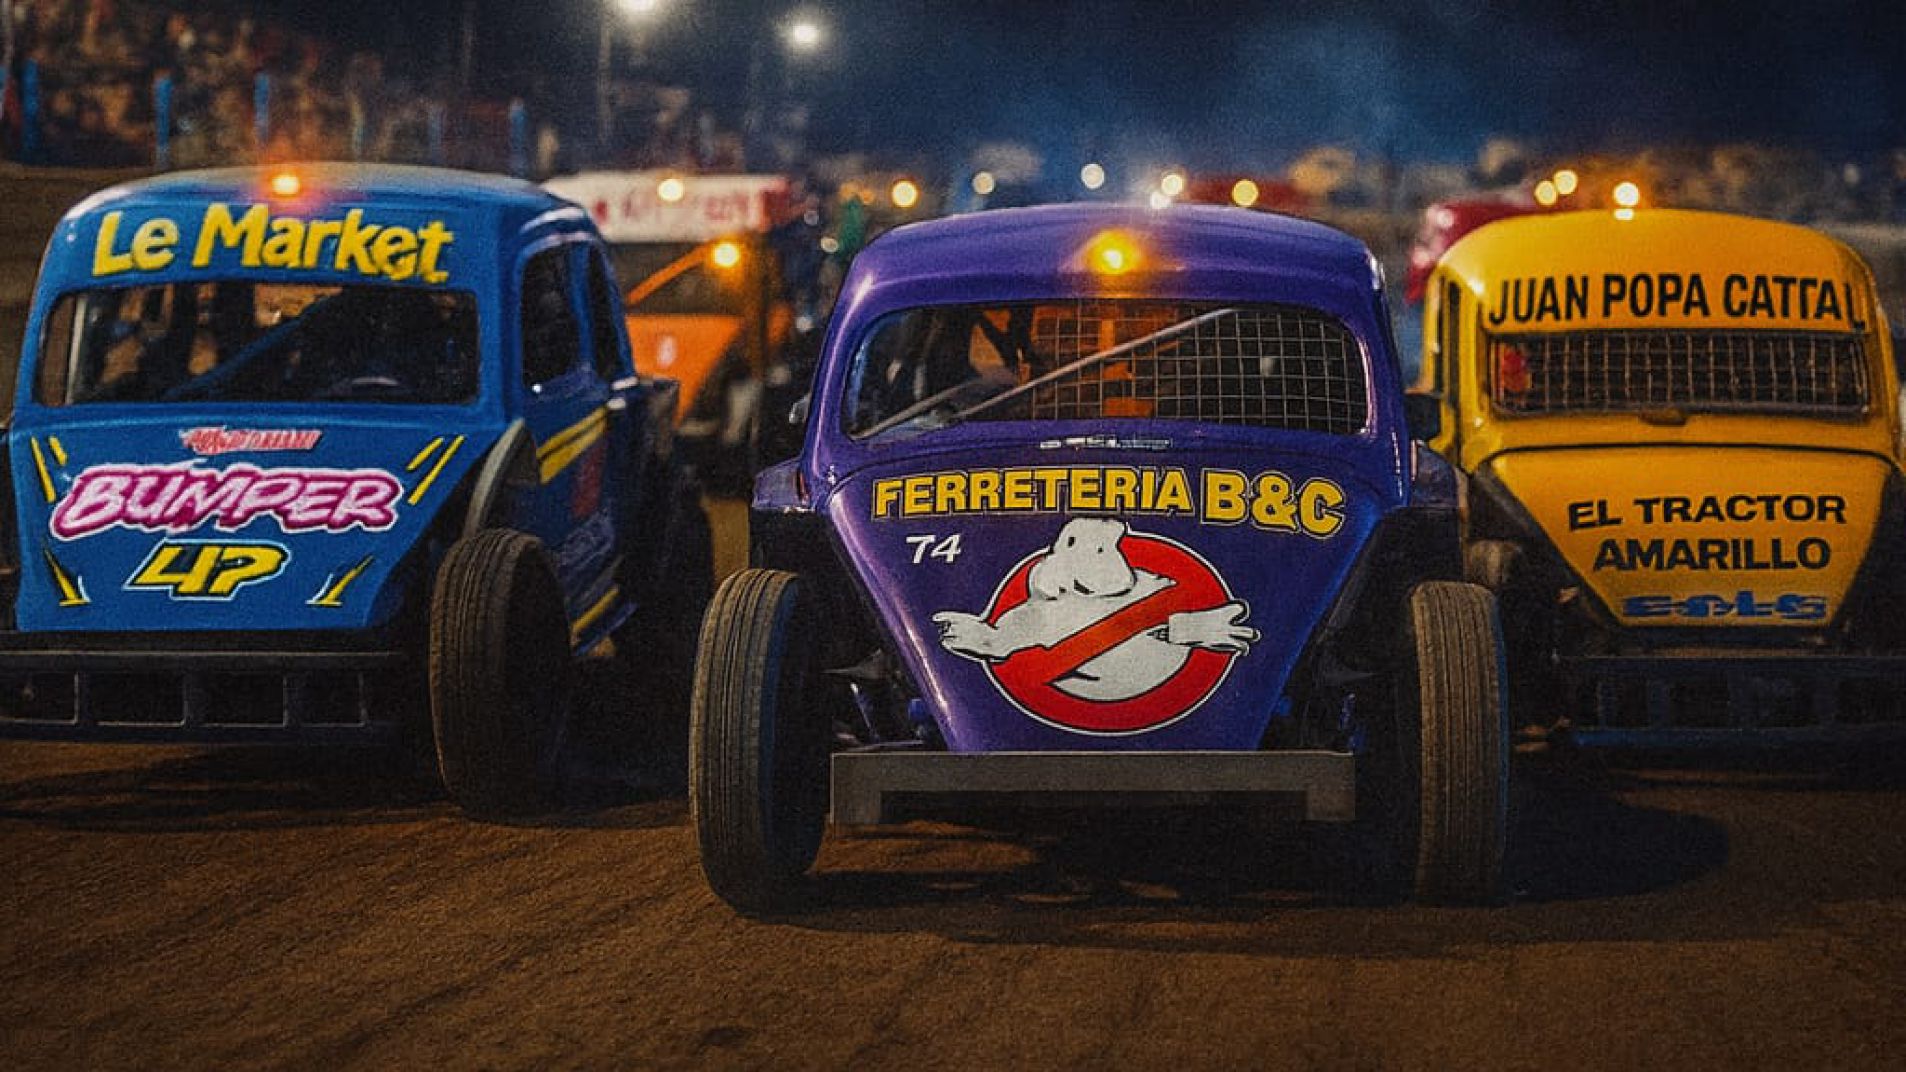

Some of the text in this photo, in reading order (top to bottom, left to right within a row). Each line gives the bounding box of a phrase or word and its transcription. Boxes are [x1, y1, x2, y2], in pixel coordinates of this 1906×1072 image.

[93, 203, 454, 284] Le Market
[1489, 275, 1590, 325] JUAN
[1603, 273, 1710, 318] POPA
[51, 462, 404, 540] BUMPER
[873, 468, 1346, 536] FERRETERIA B&C
[1568, 495, 1847, 532] EL TRACTOR
[905, 534, 962, 564] 74
[1592, 537, 1832, 573] AMARILLO
